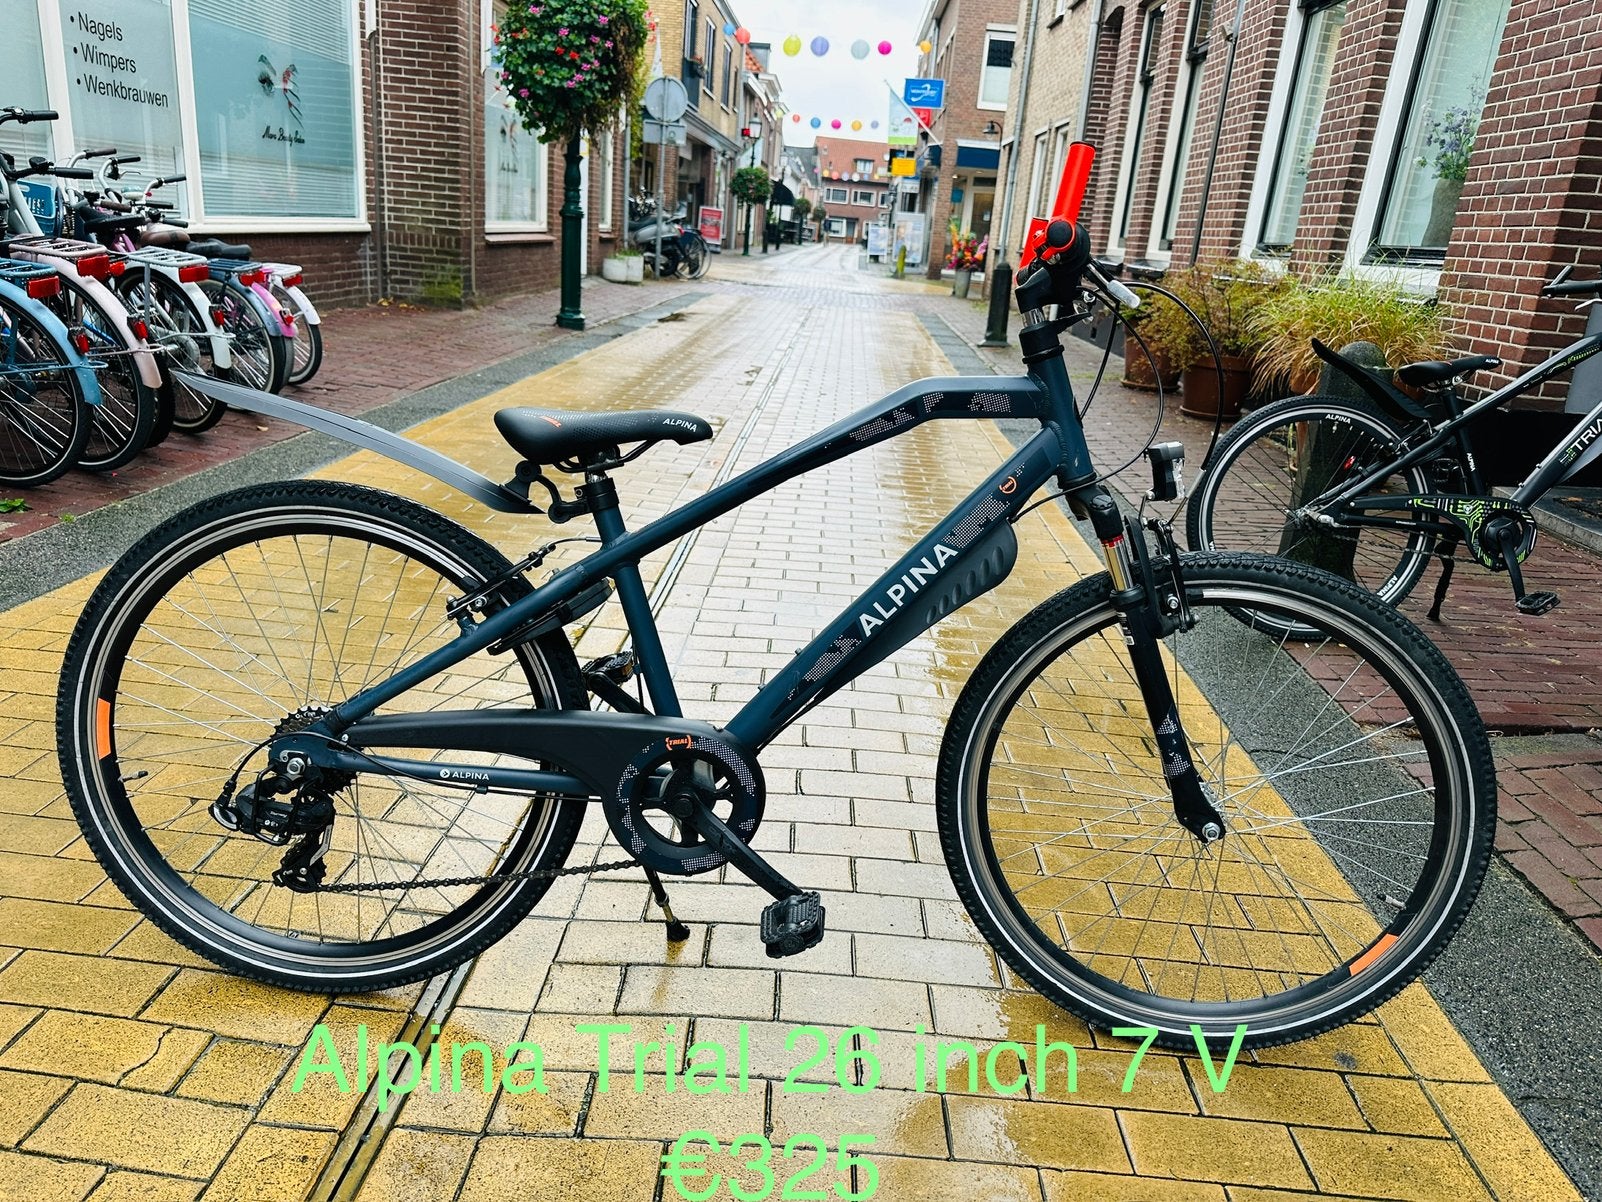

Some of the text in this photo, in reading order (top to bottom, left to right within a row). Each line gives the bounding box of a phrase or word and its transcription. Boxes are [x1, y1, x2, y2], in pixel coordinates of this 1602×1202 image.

[78, 11, 123, 41] Nagels
[80, 42, 137, 73] Wimpers
[83, 73, 169, 107] Wenkbrauwen
[663, 418, 698, 432] ALPINA
[1325, 413, 1351, 424] ALPINA
[859, 543, 959, 638] ALPINA
[452, 771, 490, 781] ALPINA
